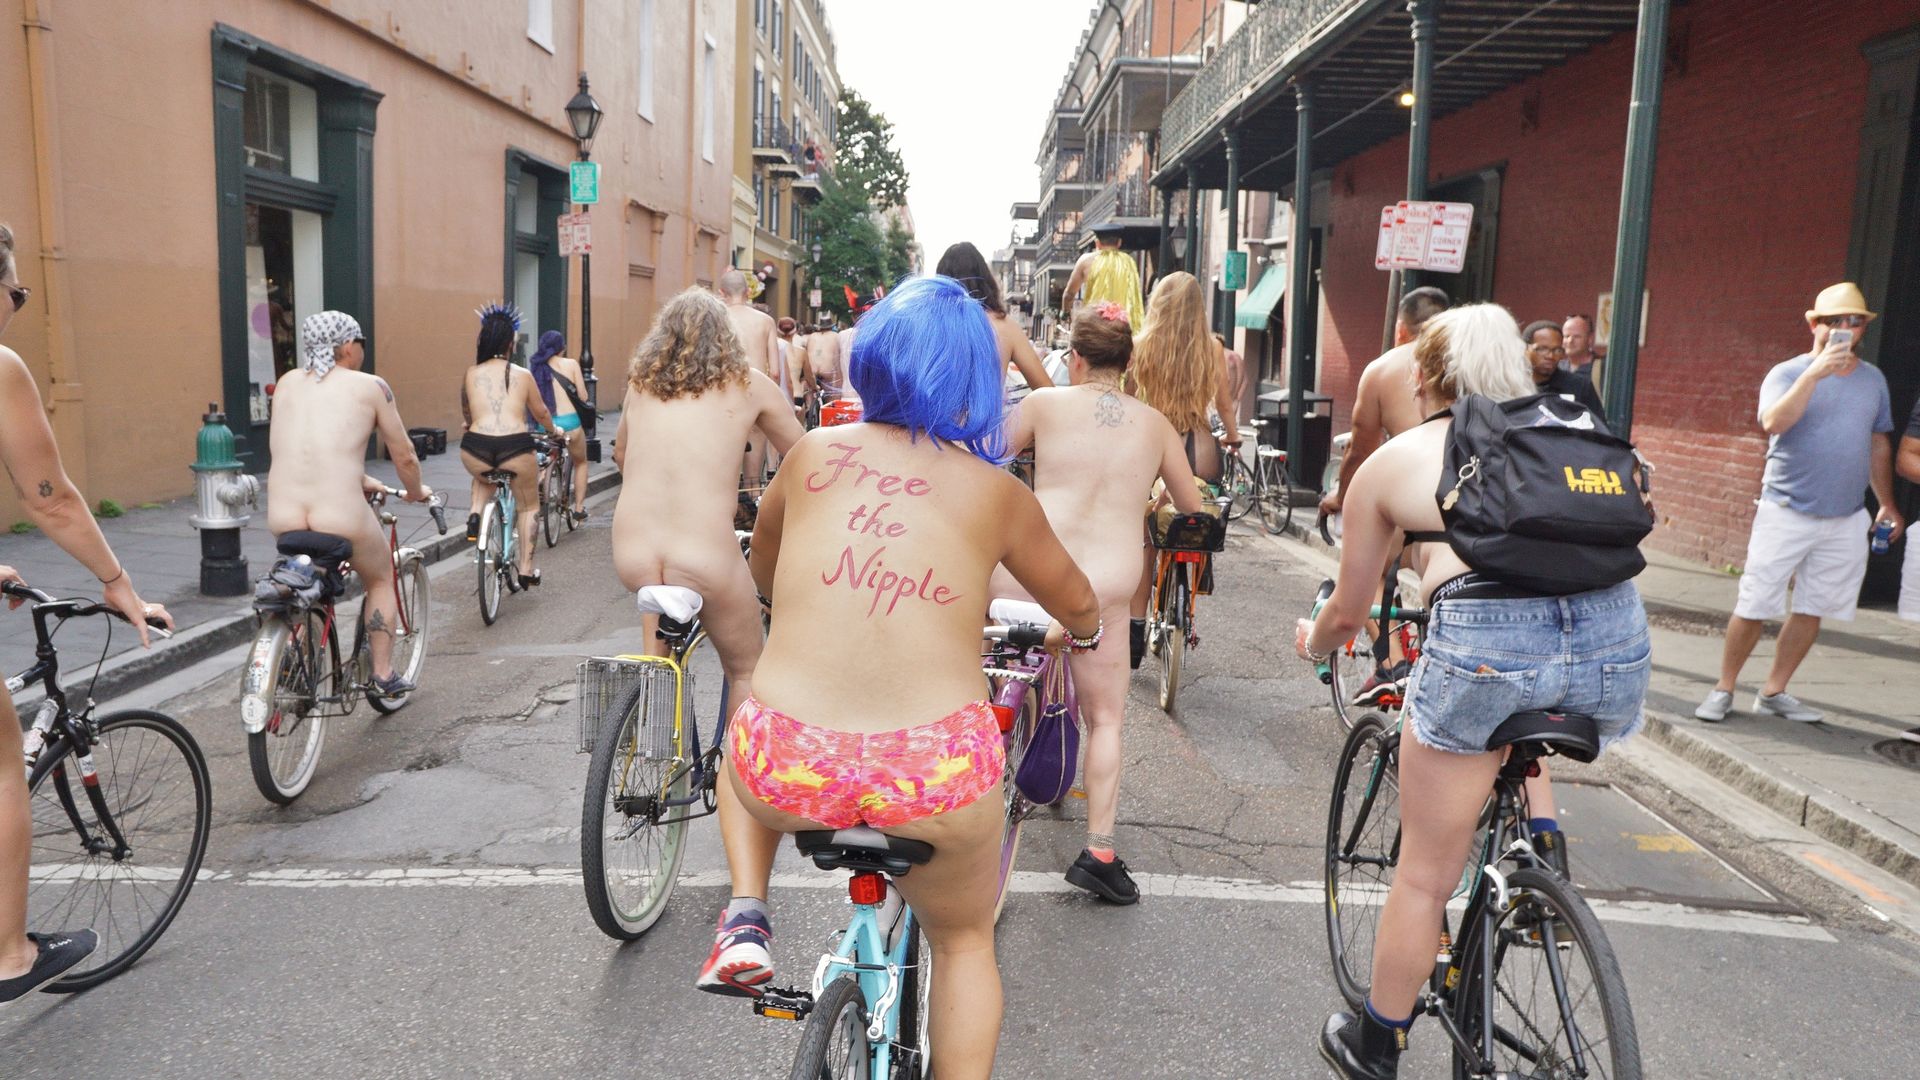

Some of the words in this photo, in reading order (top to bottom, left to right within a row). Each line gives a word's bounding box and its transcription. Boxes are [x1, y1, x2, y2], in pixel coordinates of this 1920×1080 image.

[1400, 235, 1419, 245] ZONE
[1433, 237, 1461, 247] CORNER
[1428, 256, 1459, 266] ANYTIME
[804, 442, 932, 497] Free
[1563, 466, 1621, 488] LSU
[847, 502, 909, 539] the
[821, 545, 964, 619] Nipple
[1439, 575, 1467, 599] PINK
